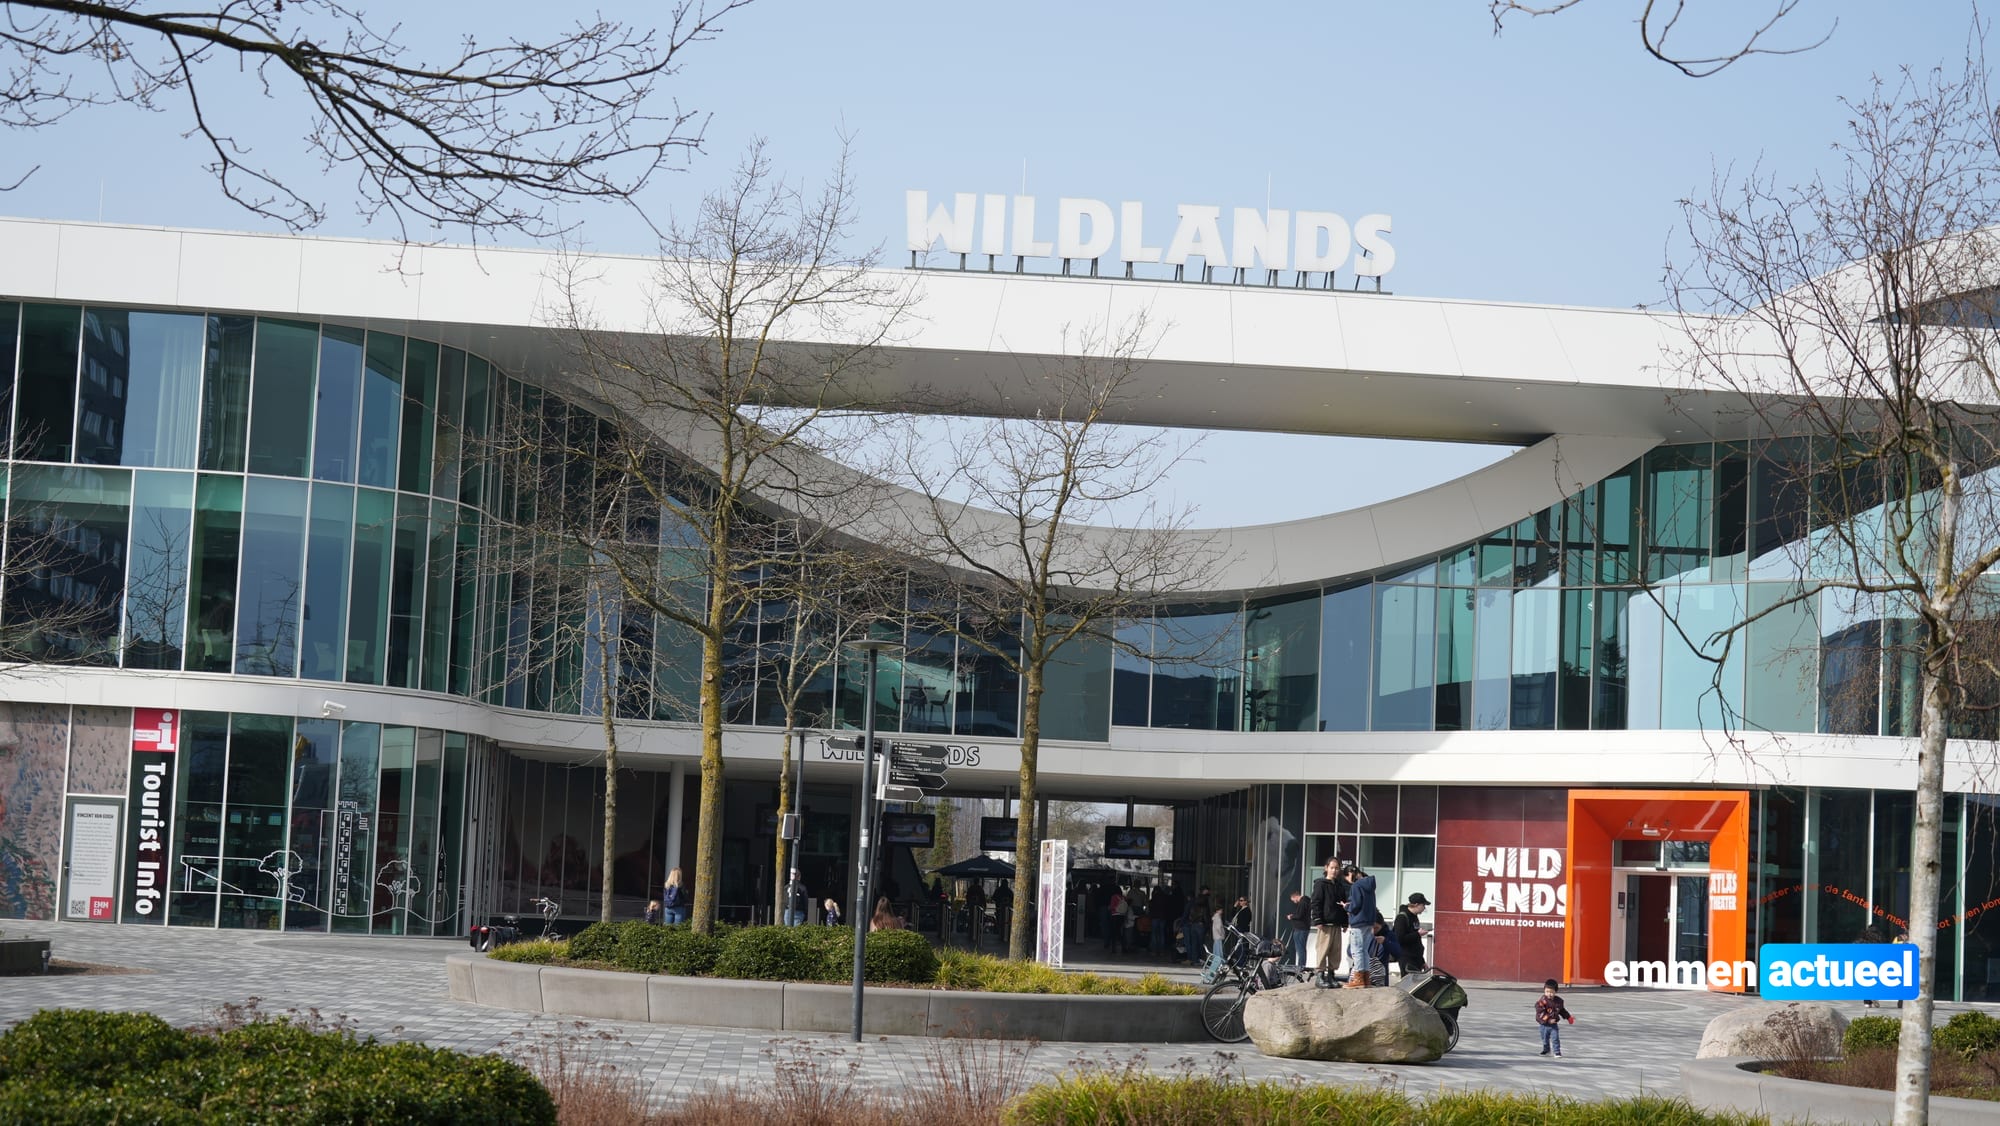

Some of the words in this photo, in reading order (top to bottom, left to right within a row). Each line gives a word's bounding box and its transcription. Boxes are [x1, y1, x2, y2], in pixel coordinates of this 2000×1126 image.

[906, 189, 1396, 277] WILDLANDS
[138, 762, 167, 851] Tourist
[1477, 846, 1562, 879] WILD
[135, 861, 161, 915] Info
[1709, 872, 1737, 894] ATLAS
[93, 900, 109, 909] EMM
[93, 908, 102, 916] EN
[1824, 884, 1839, 895] de
[1841, 888, 1885, 917] fantaie
[1469, 918, 1516, 927] ADVENTURE
[1517, 919, 1535, 927] ZOO
[1536, 920, 1565, 929] EMMEN
